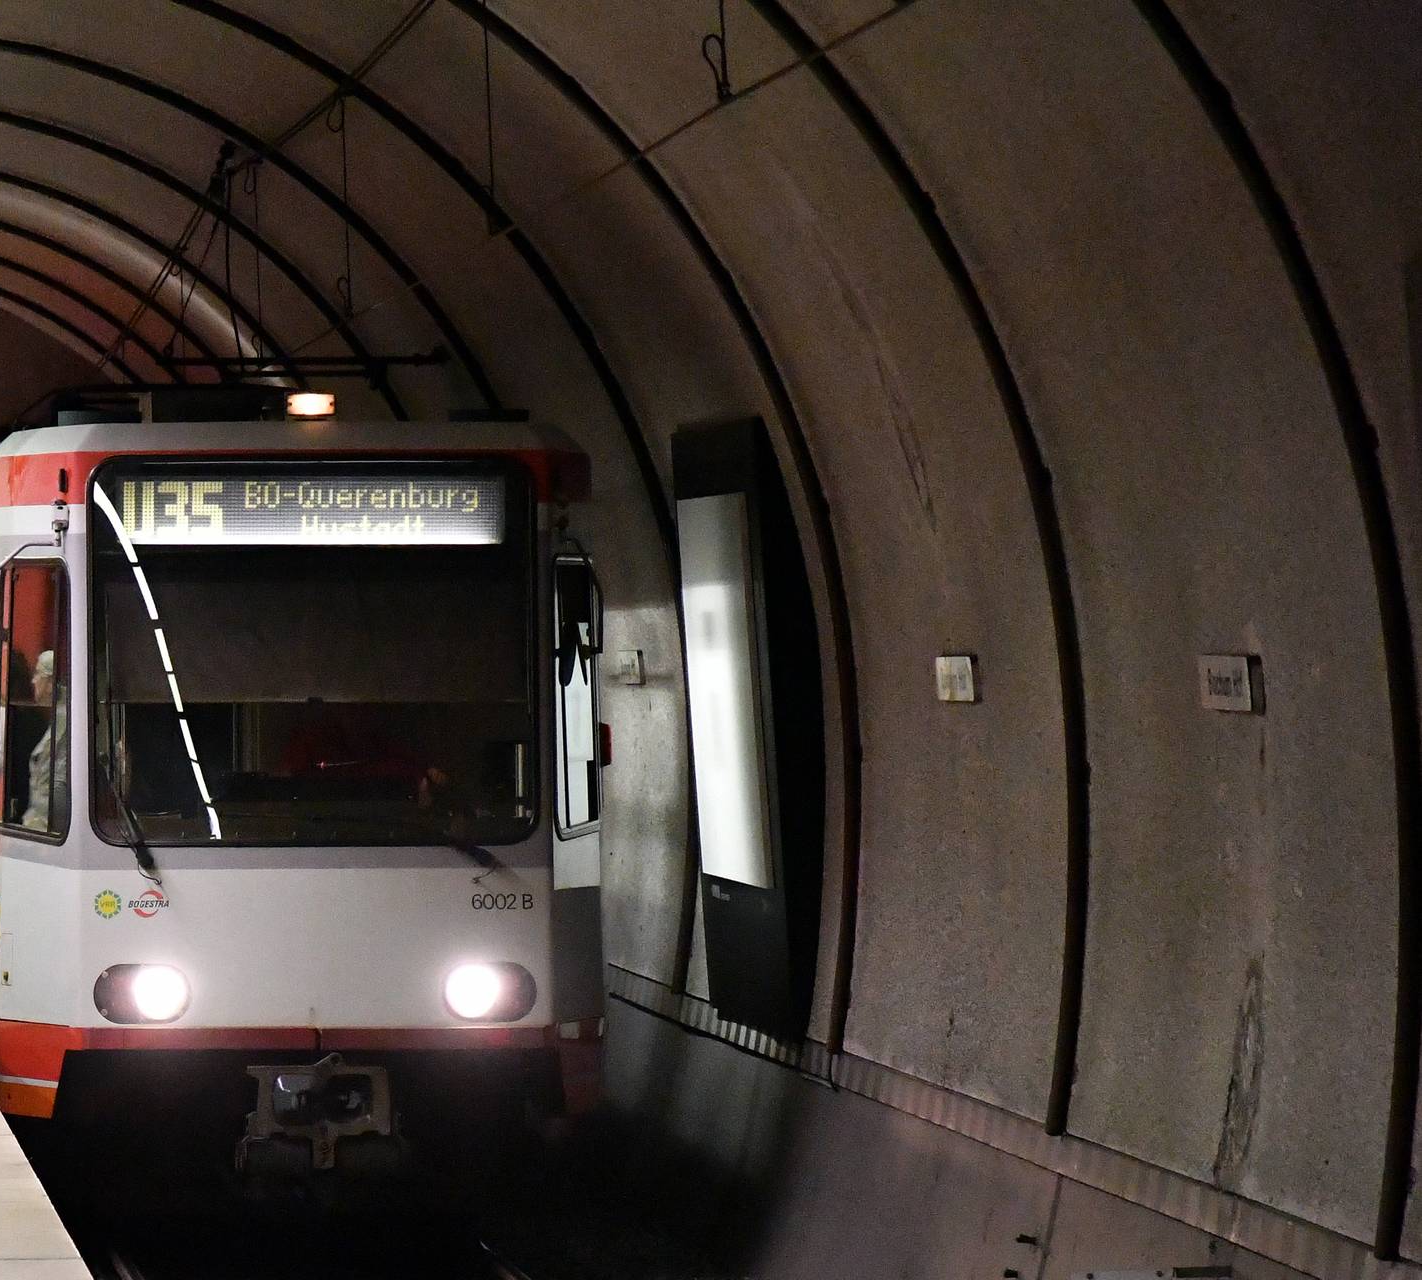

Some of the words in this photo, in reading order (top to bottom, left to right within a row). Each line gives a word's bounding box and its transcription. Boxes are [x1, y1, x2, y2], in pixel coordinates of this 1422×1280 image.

[123, 481, 224, 537] U35
[244, 481, 480, 513] BO-Querenburg
[128, 900, 170, 908] BOGESTRA
[471, 893, 517, 910] 6002
[522, 893, 534, 910] B
